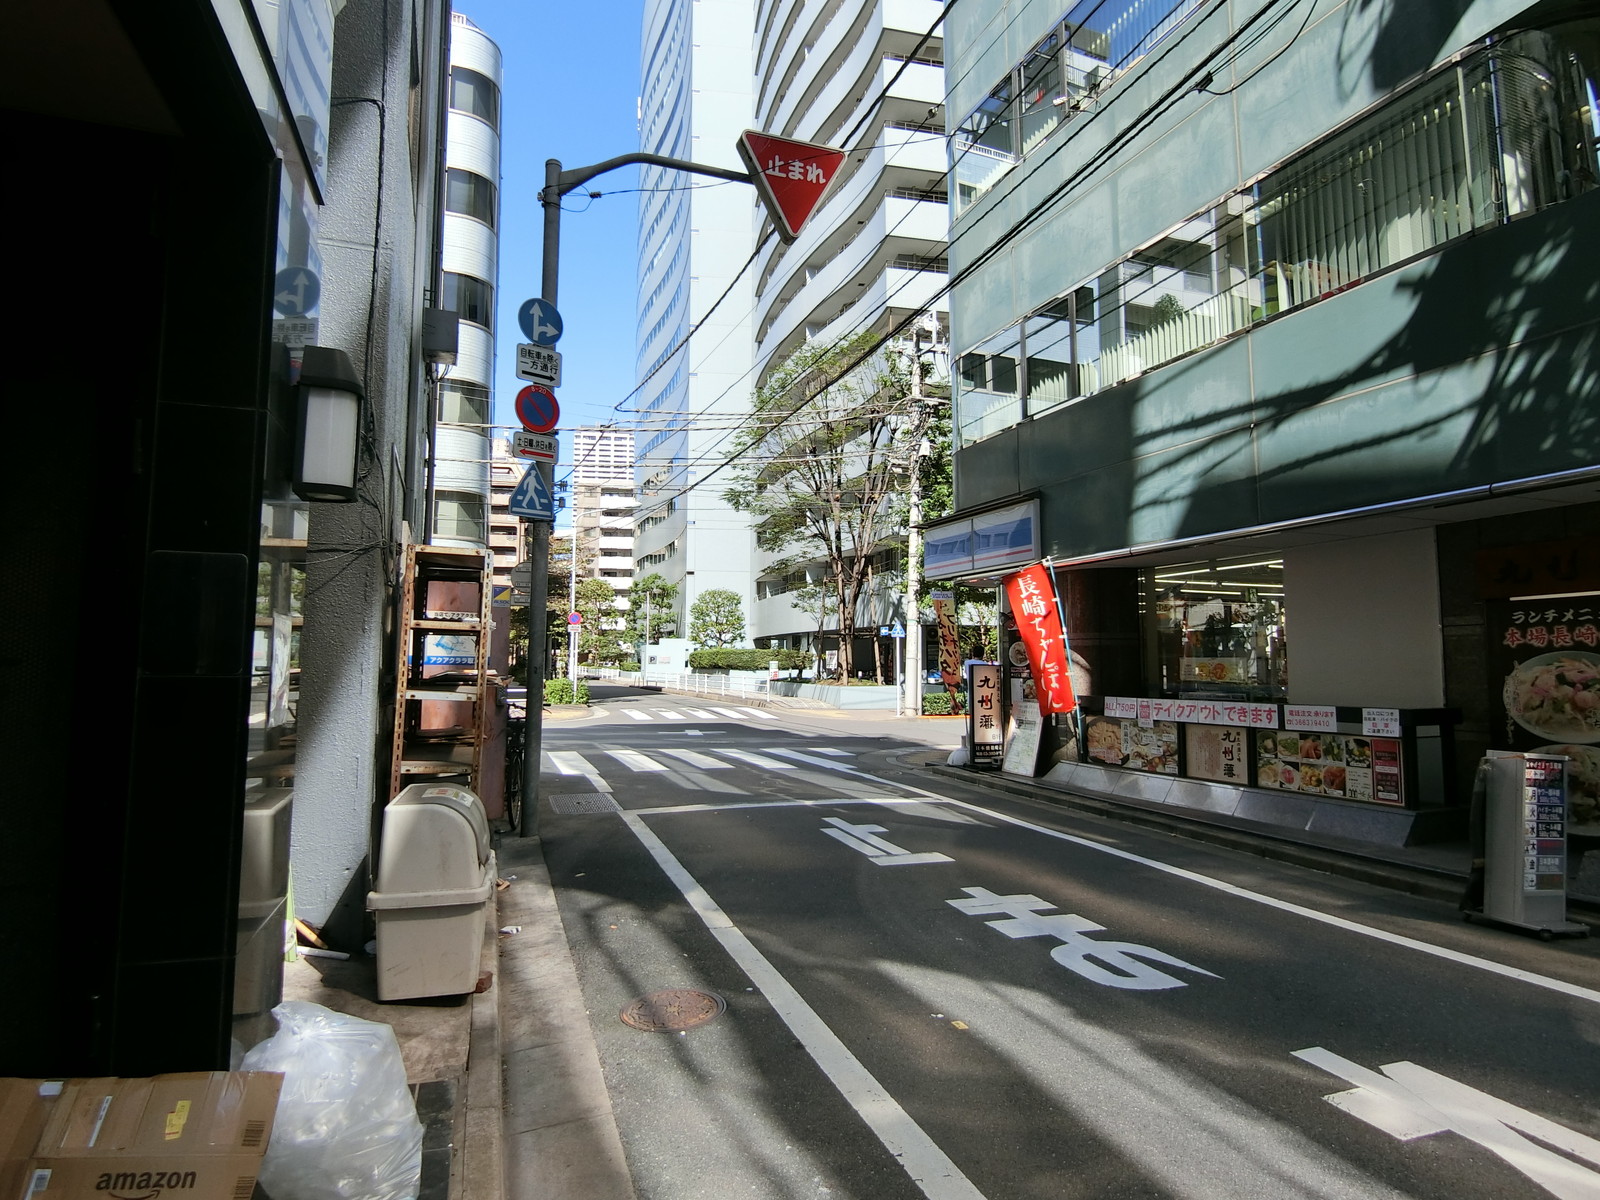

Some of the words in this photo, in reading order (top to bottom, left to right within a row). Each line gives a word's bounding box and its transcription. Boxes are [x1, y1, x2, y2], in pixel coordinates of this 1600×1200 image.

[765, 154, 827, 184] 止まれ
[520, 347, 559, 365] 自転車を除く
[520, 360, 559, 375] 一方通行
[1510, 608, 1600, 624] ランチメニ
[1016, 574, 1064, 709] 長崎ちゃんぽん
[1504, 625, 1598, 648] 本場長崎
[1153, 703, 1277, 725] テイクアウトできます
[96, 1170, 197, 1191] amazon
